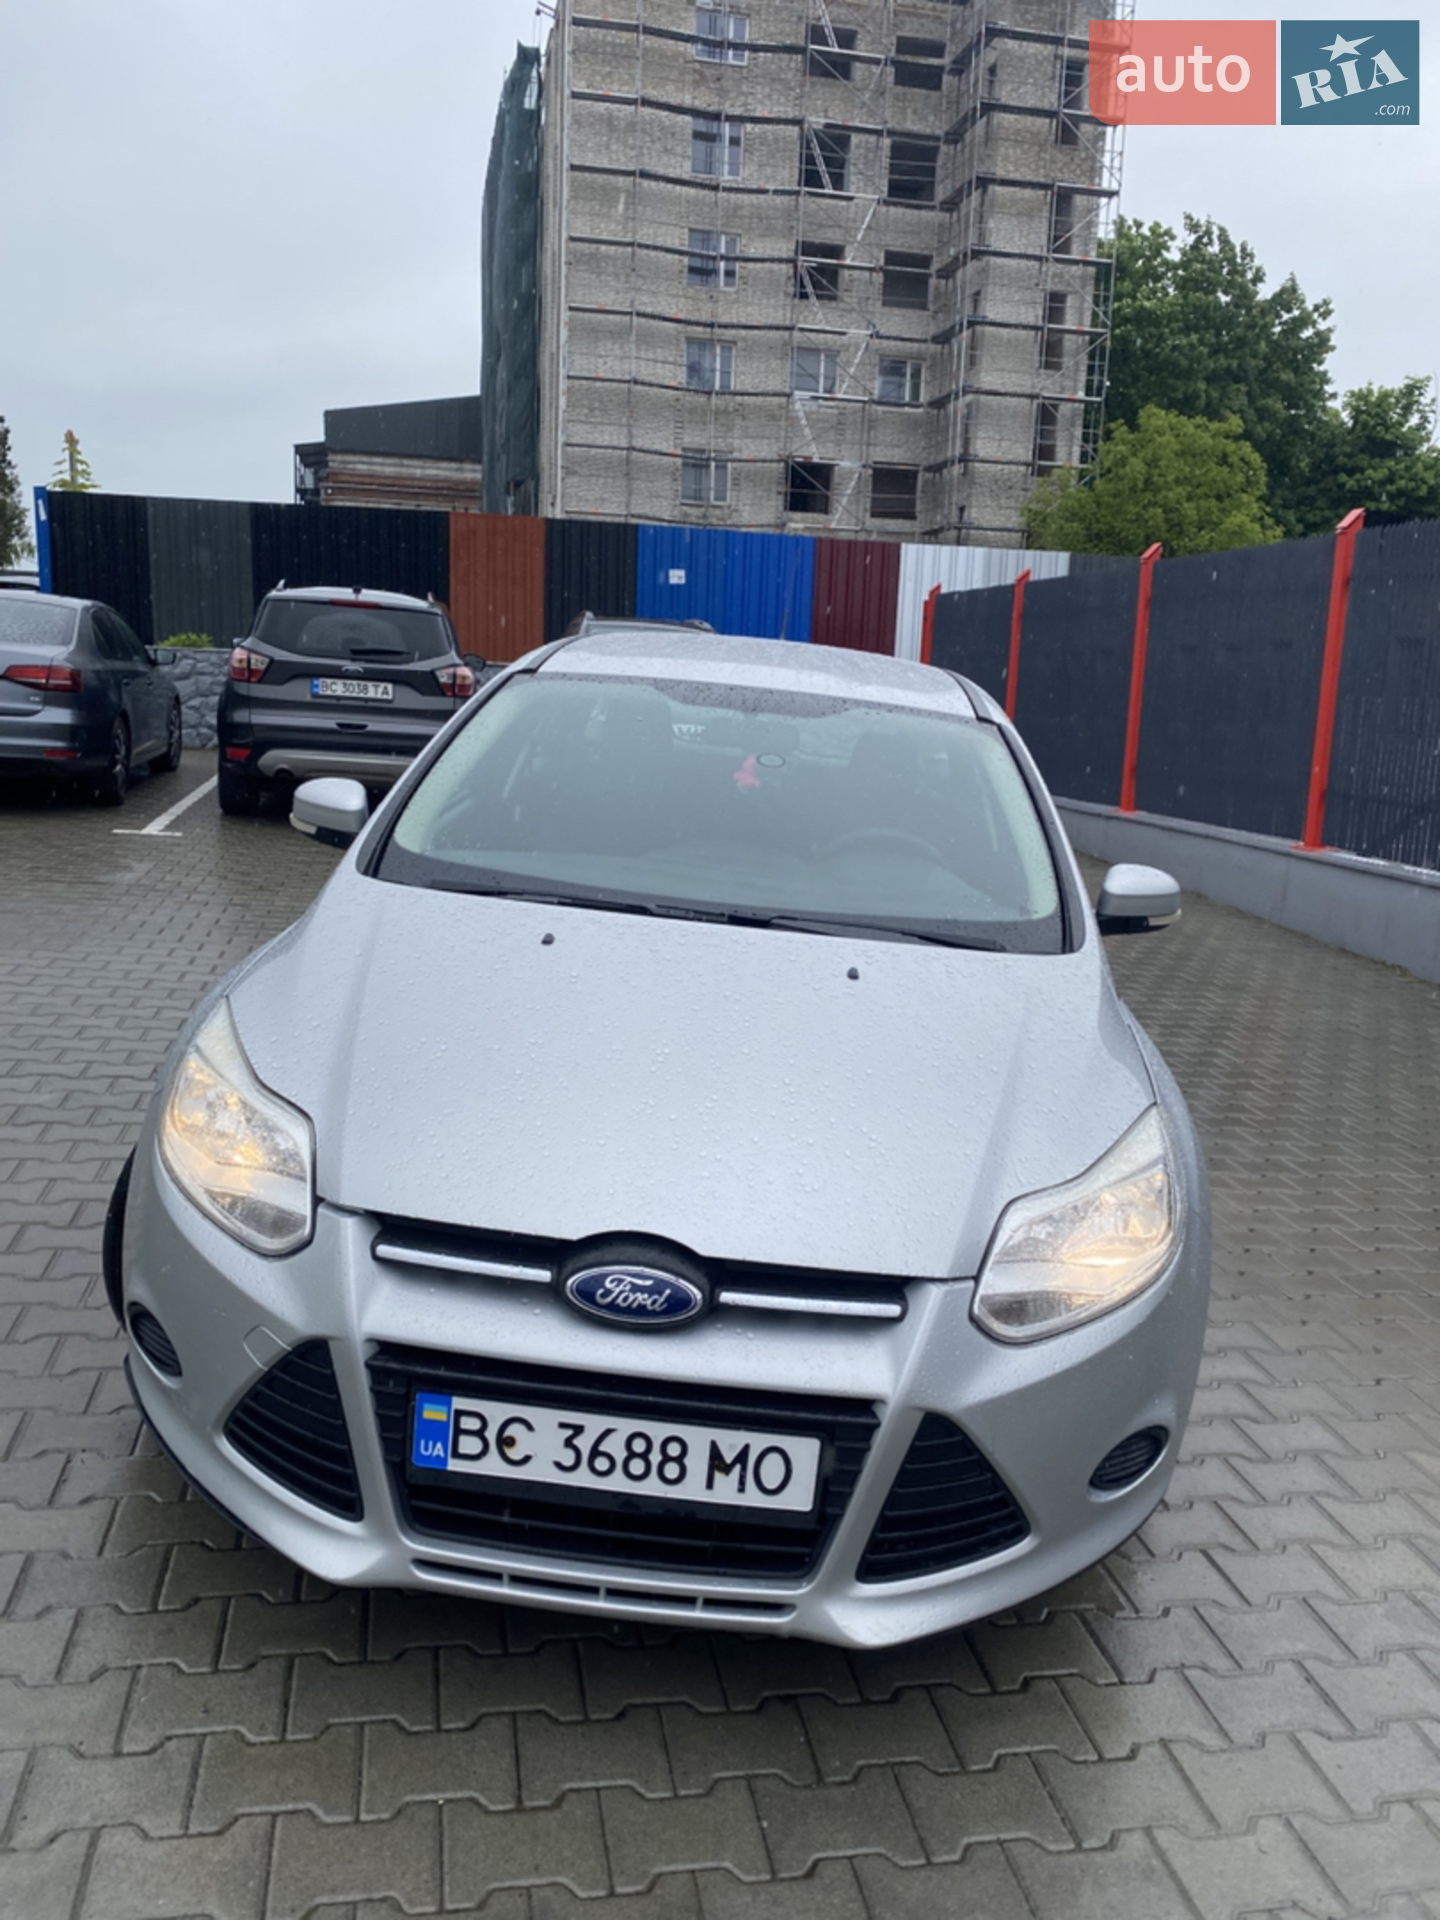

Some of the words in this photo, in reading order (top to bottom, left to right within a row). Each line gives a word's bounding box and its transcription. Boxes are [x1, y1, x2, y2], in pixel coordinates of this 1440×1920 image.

[321, 681, 338, 693] BC
[341, 682, 369, 695] 3038
[372, 684, 390, 696] TA
[595, 1274, 671, 1311] Ford
[419, 1440, 445, 1459] UA
[552, 1422, 690, 1486] 3688
[705, 1439, 794, 1496] MO
